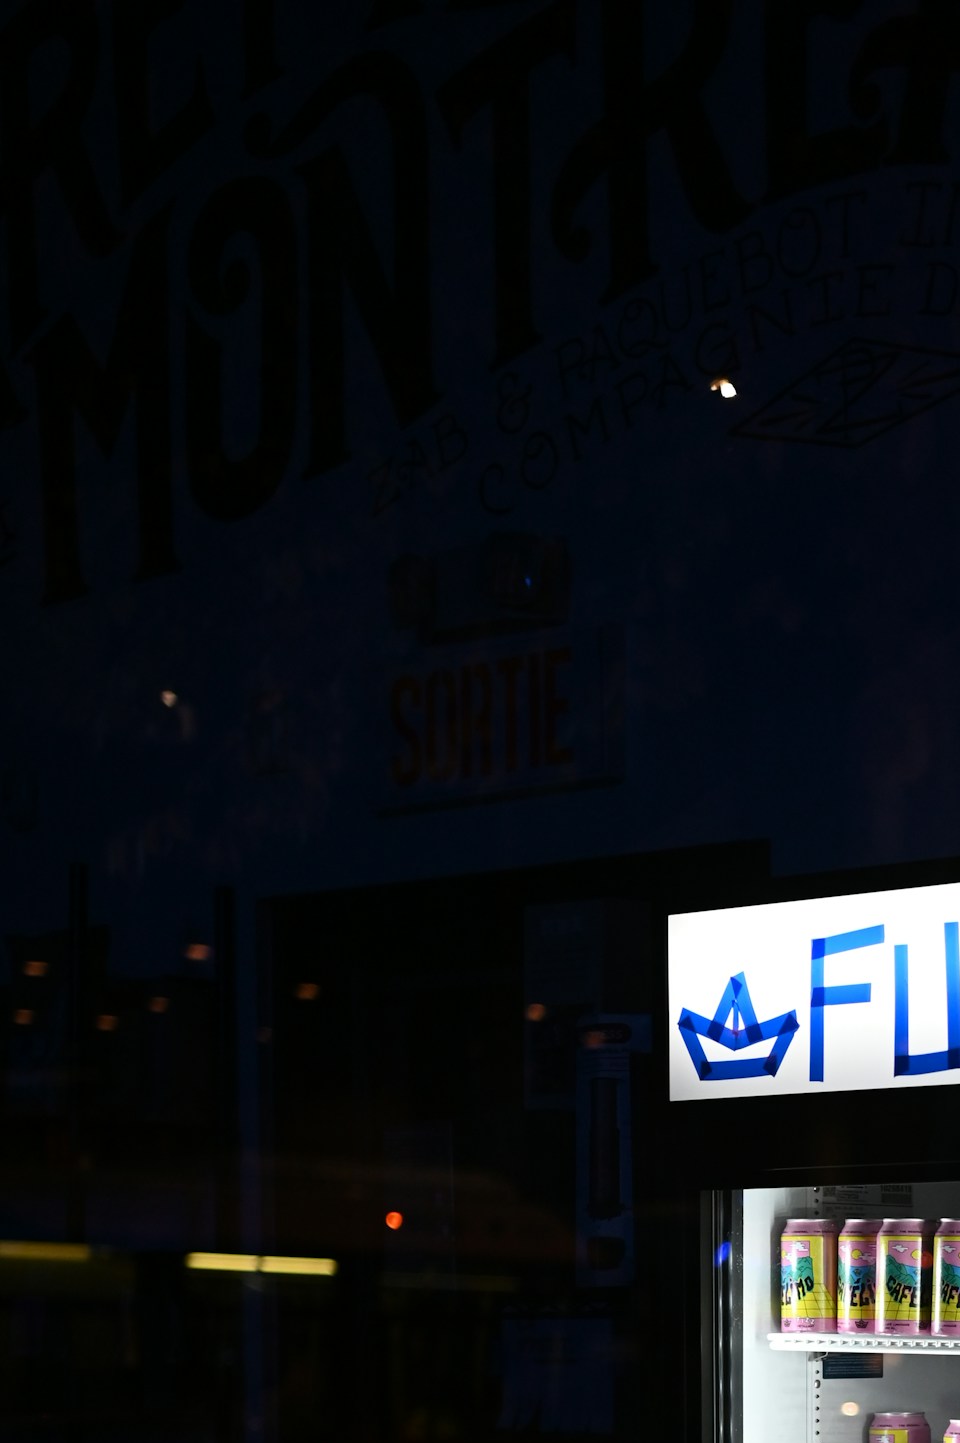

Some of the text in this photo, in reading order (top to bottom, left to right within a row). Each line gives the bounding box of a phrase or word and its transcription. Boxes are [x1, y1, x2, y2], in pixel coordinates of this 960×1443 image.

[477, 264, 895, 516] COMPAGNIE
[494, 371, 533, 436] &
[554, 190, 869, 400] PAQUEBOT
[389, 646, 574, 788] SORTIE
